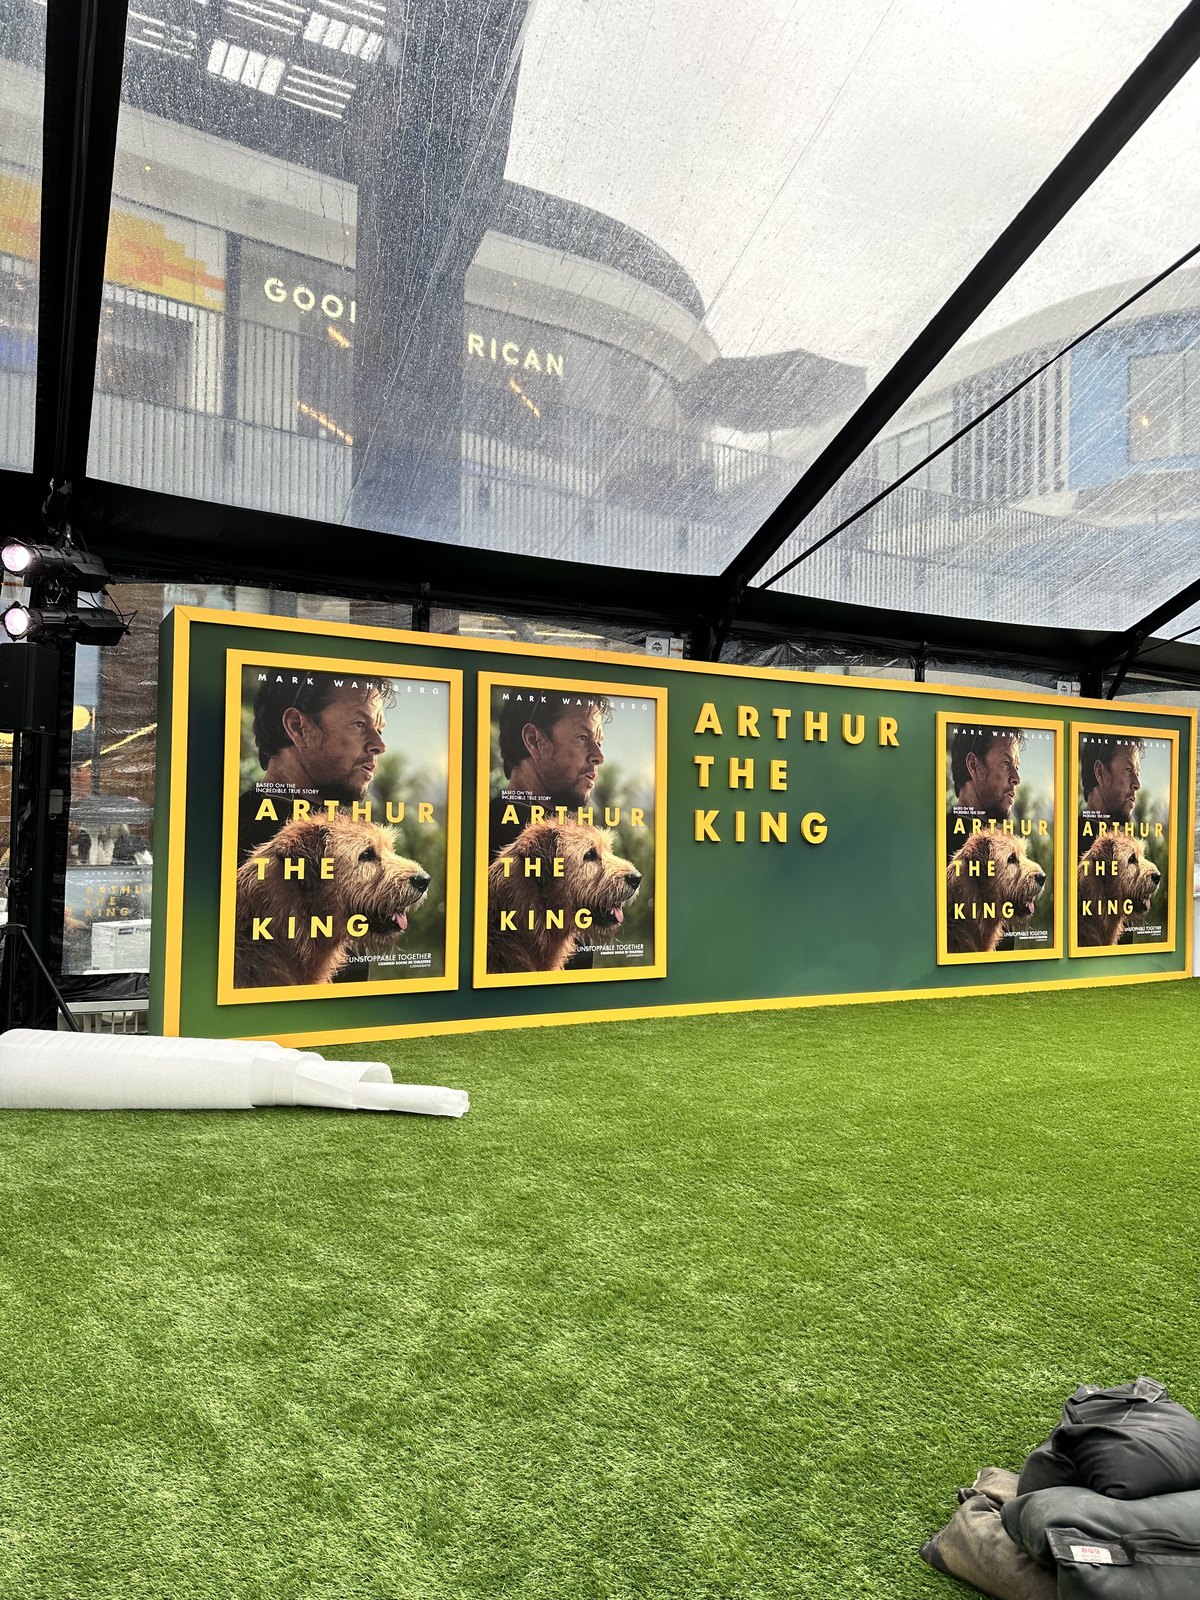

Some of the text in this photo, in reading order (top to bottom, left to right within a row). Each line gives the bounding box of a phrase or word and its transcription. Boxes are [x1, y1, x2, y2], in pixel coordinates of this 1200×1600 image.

[467, 333, 563, 375] RICAN
[257, 673, 439, 695] MARK WAHLBERG
[502, 693, 647, 711] MARK WAHLBERG
[694, 702, 900, 747] ARTHUR
[952, 728, 983, 736] MARK
[694, 755, 788, 791] THE
[255, 798, 436, 824] ARTHUR
[501, 804, 645, 827] ARTHUR
[694, 809, 828, 845] KING
[953, 817, 1049, 836] ARTHUR
[1082, 821, 1164, 838] ARTHUR
[253, 857, 335, 881] THE
[501, 857, 565, 878] THE
[954, 860, 996, 877] THE
[1083, 860, 1118, 876] THE
[954, 901, 1015, 920] KING
[1082, 898, 1134, 916] KING
[252, 914, 369, 941] KING
[500, 908, 593, 931] KING
[348, 952, 432, 963] UNSTOPPABLE TOGETHER
[616, 943, 644, 951] TOGETHER
